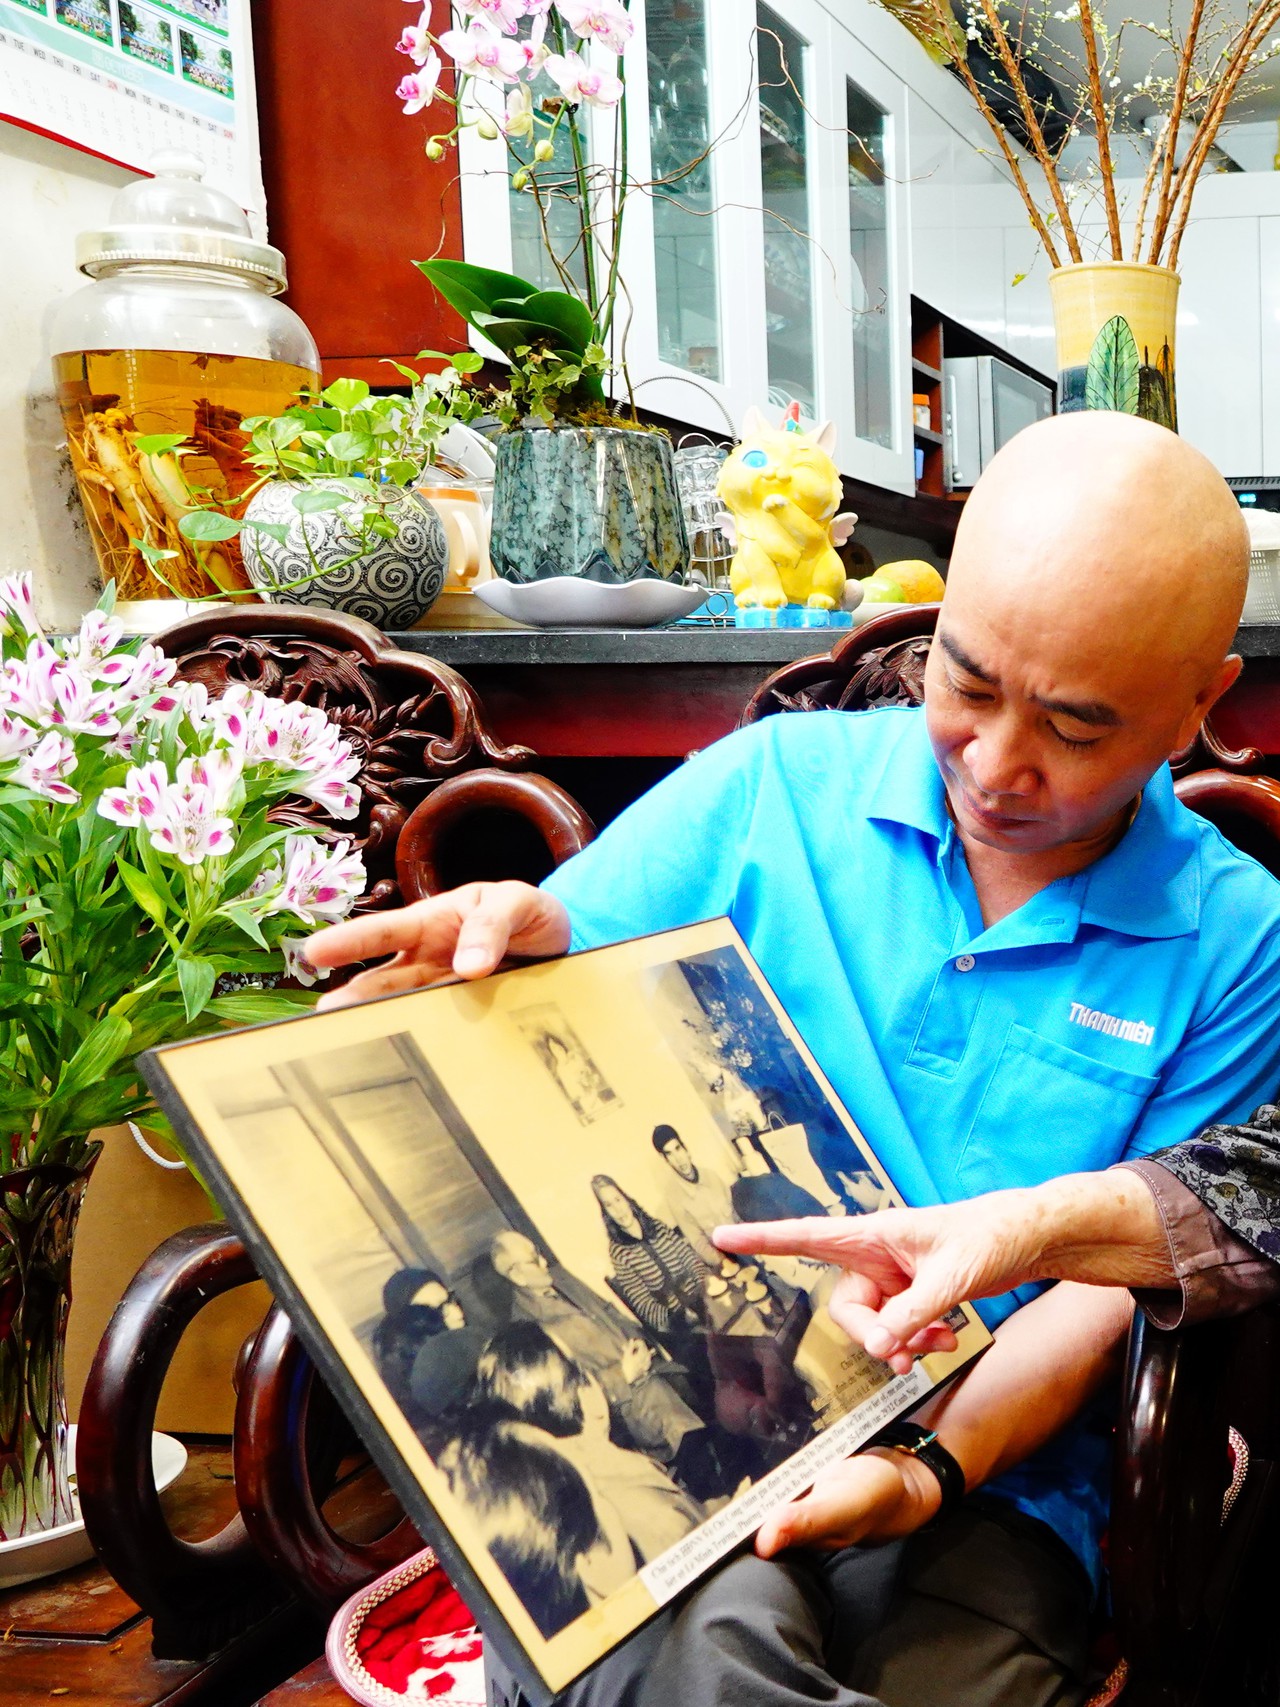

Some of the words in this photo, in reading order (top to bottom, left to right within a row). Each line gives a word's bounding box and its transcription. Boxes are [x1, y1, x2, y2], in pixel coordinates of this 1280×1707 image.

[13, 38, 25, 51] TUE
[33, 47, 46, 60] WED
[53, 55, 64, 68] THU
[73, 64, 82, 76] FRI
[90, 71, 101, 83] SAT
[124, 86, 137, 98] MON
[142, 94, 152, 106] TUE
[158, 102, 170, 114] WED
[175, 108, 185, 120] THU
[192, 115, 201, 127] FRI
[1068, 1001, 1122, 1038] THANH
[1117, 1020, 1156, 1046] NIÊN
